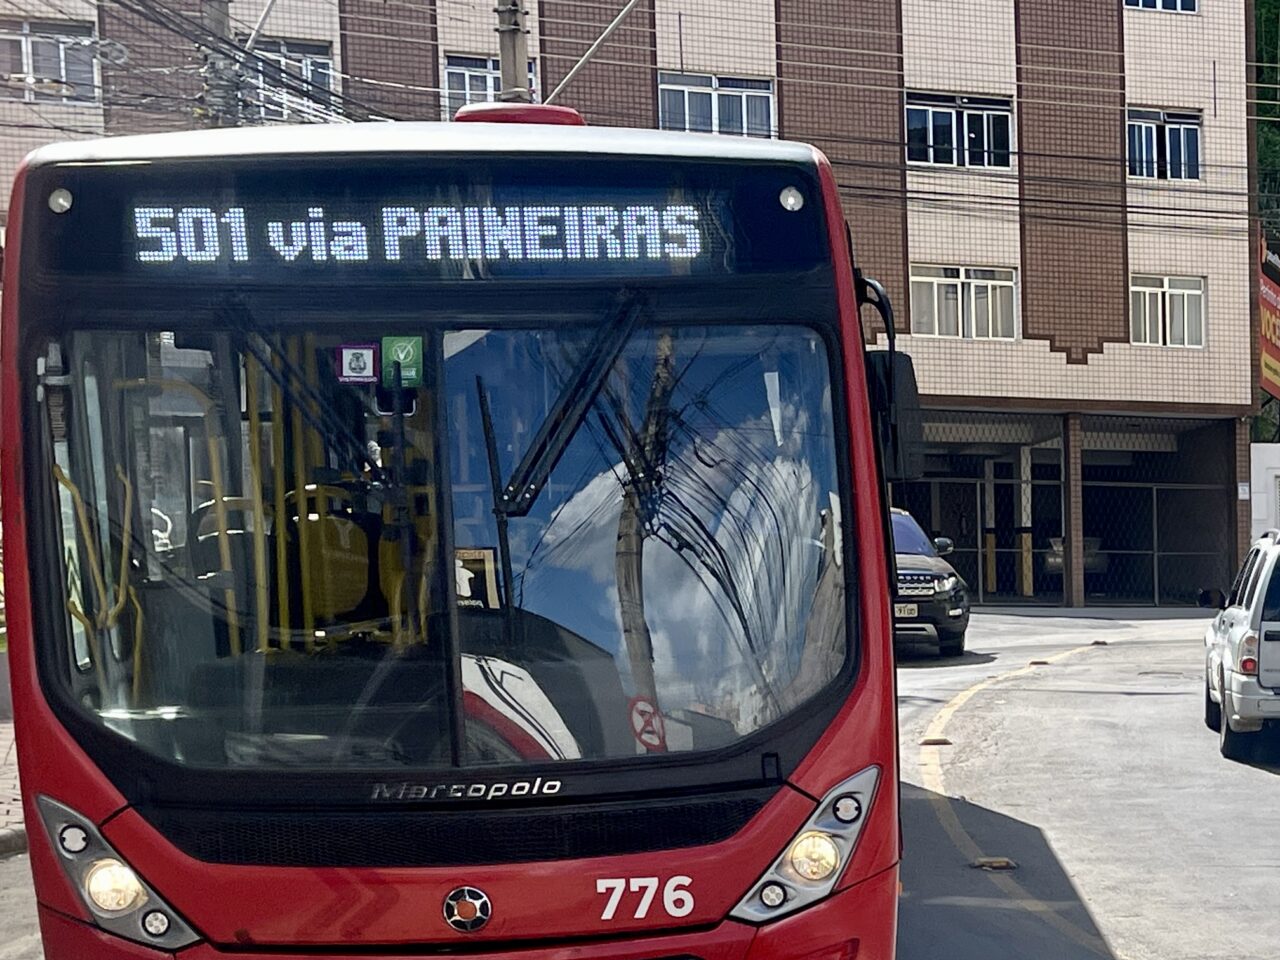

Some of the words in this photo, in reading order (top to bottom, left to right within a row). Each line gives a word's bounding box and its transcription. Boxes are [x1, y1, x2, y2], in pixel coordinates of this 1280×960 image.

[134, 207, 248, 261] 501
[267, 207, 369, 261] via
[382, 206, 701, 259] PAINEIRAS
[370, 777, 561, 800] Marcopolo
[596, 875, 694, 920] 776
